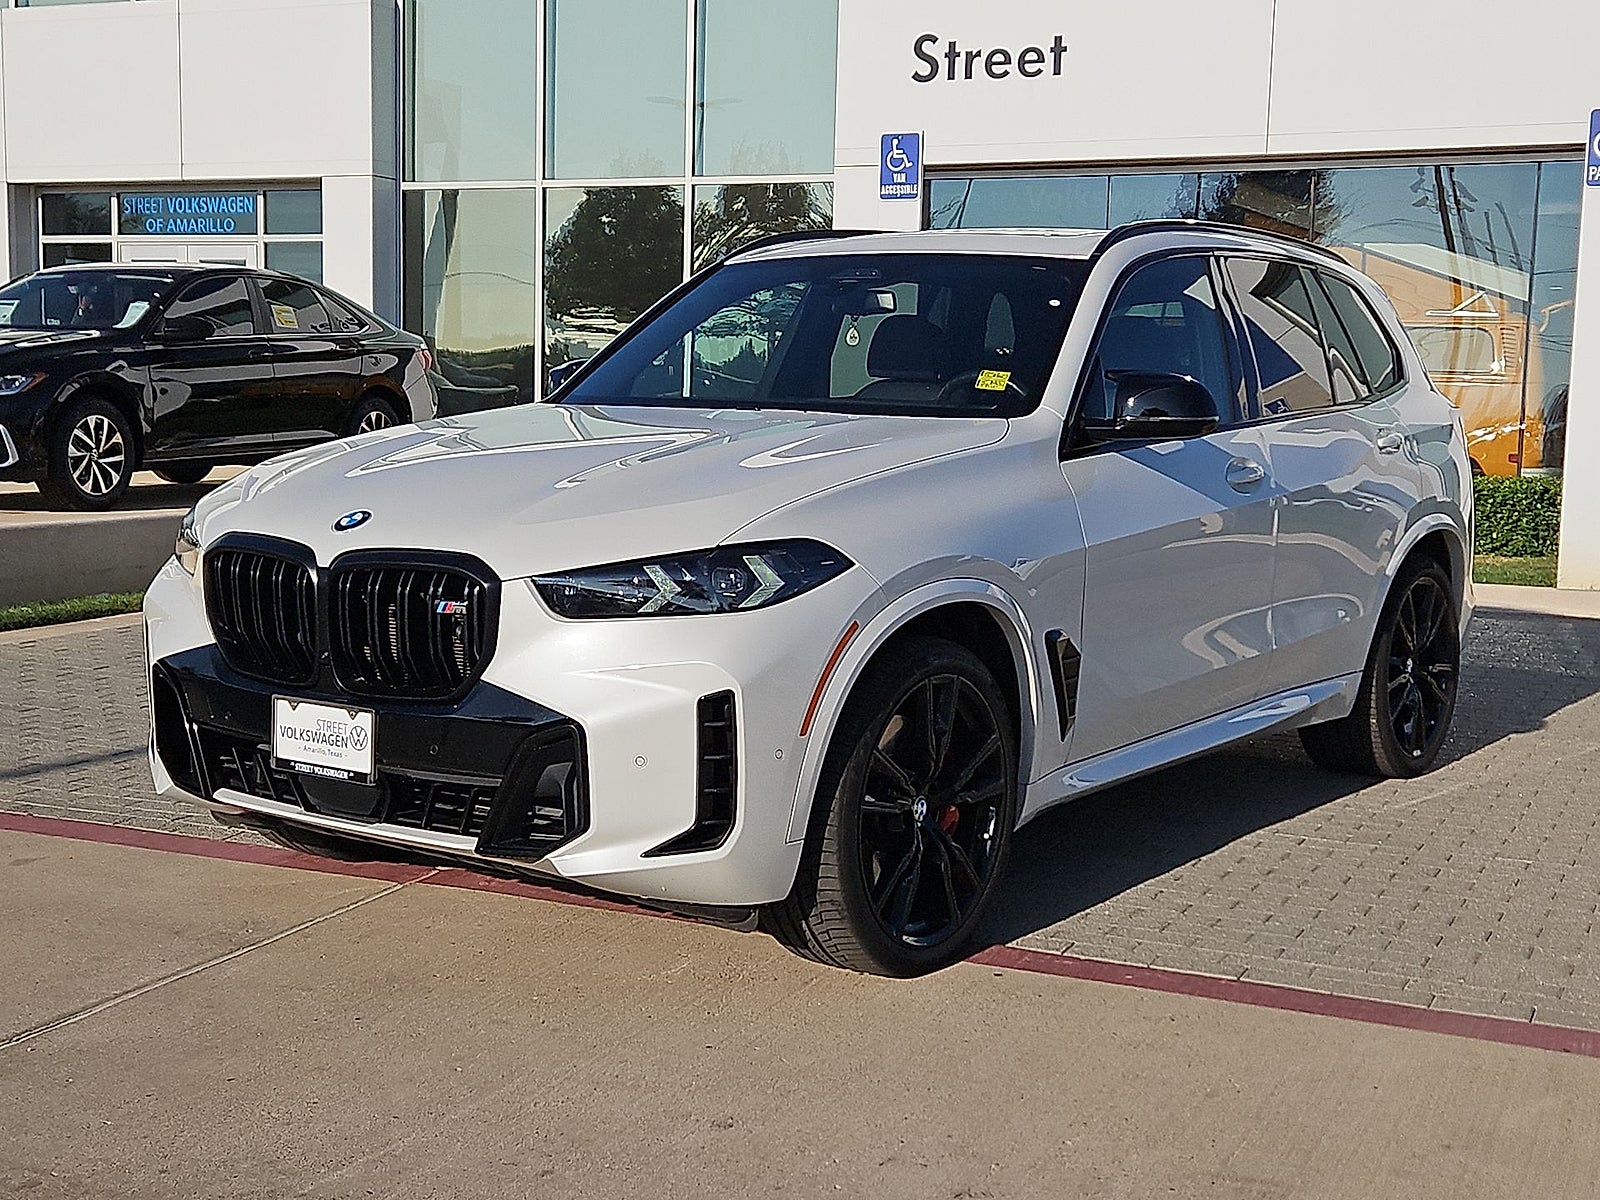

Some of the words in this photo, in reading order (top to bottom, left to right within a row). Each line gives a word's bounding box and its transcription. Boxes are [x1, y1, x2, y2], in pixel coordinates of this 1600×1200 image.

[911, 33, 1068, 83] Street
[892, 172, 907, 183] VAN
[881, 184, 918, 195] ACCESSIBLE
[123, 197, 165, 214] STREET
[167, 196, 254, 213] VOLKSWAGEN
[145, 218, 164, 232] OF
[166, 217, 235, 232] AMARILLO
[316, 718, 349, 736] STREET
[279, 724, 349, 749] VOLKSWAGEN
